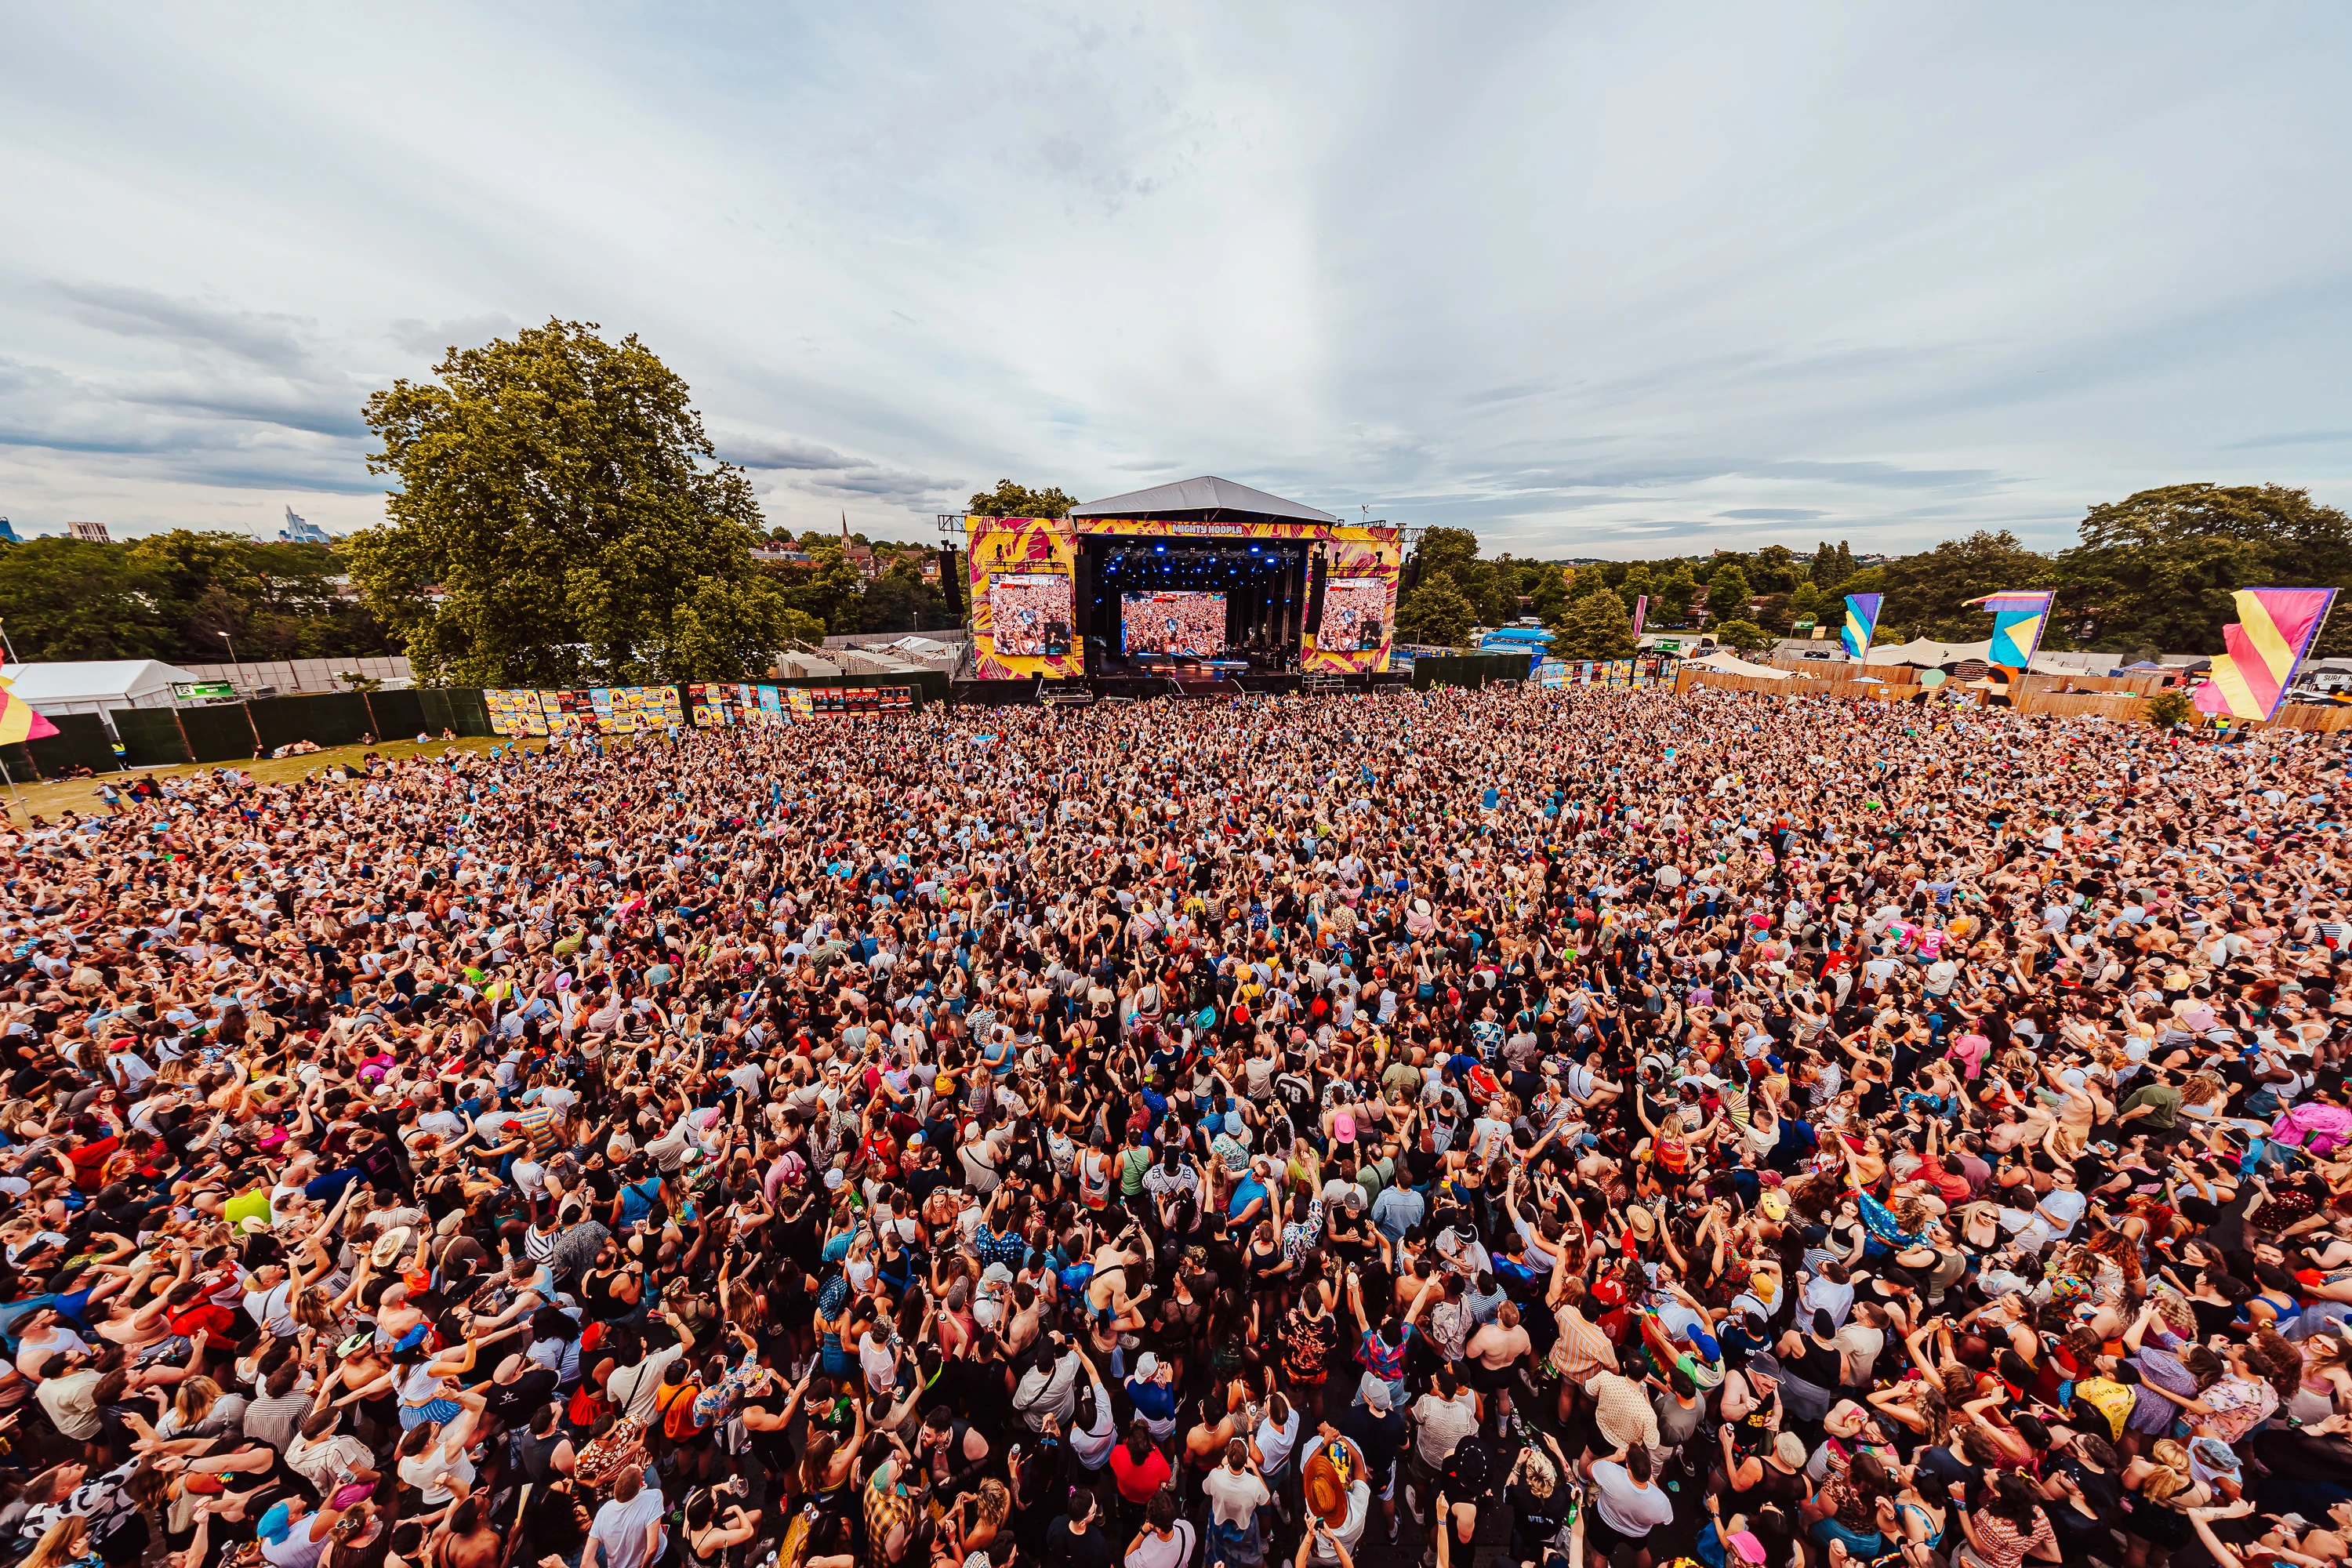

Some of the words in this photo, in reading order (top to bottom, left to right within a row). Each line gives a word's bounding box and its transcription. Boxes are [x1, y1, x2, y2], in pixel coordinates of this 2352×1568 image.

[1172, 524, 1207, 534] MIGHTY
[1208, 525, 1243, 535] HOOPLA
[1925, 937, 1940, 948] 12
[1279, 1083, 1301, 1104] 78
[1744, 1348, 1755, 1356] RED
